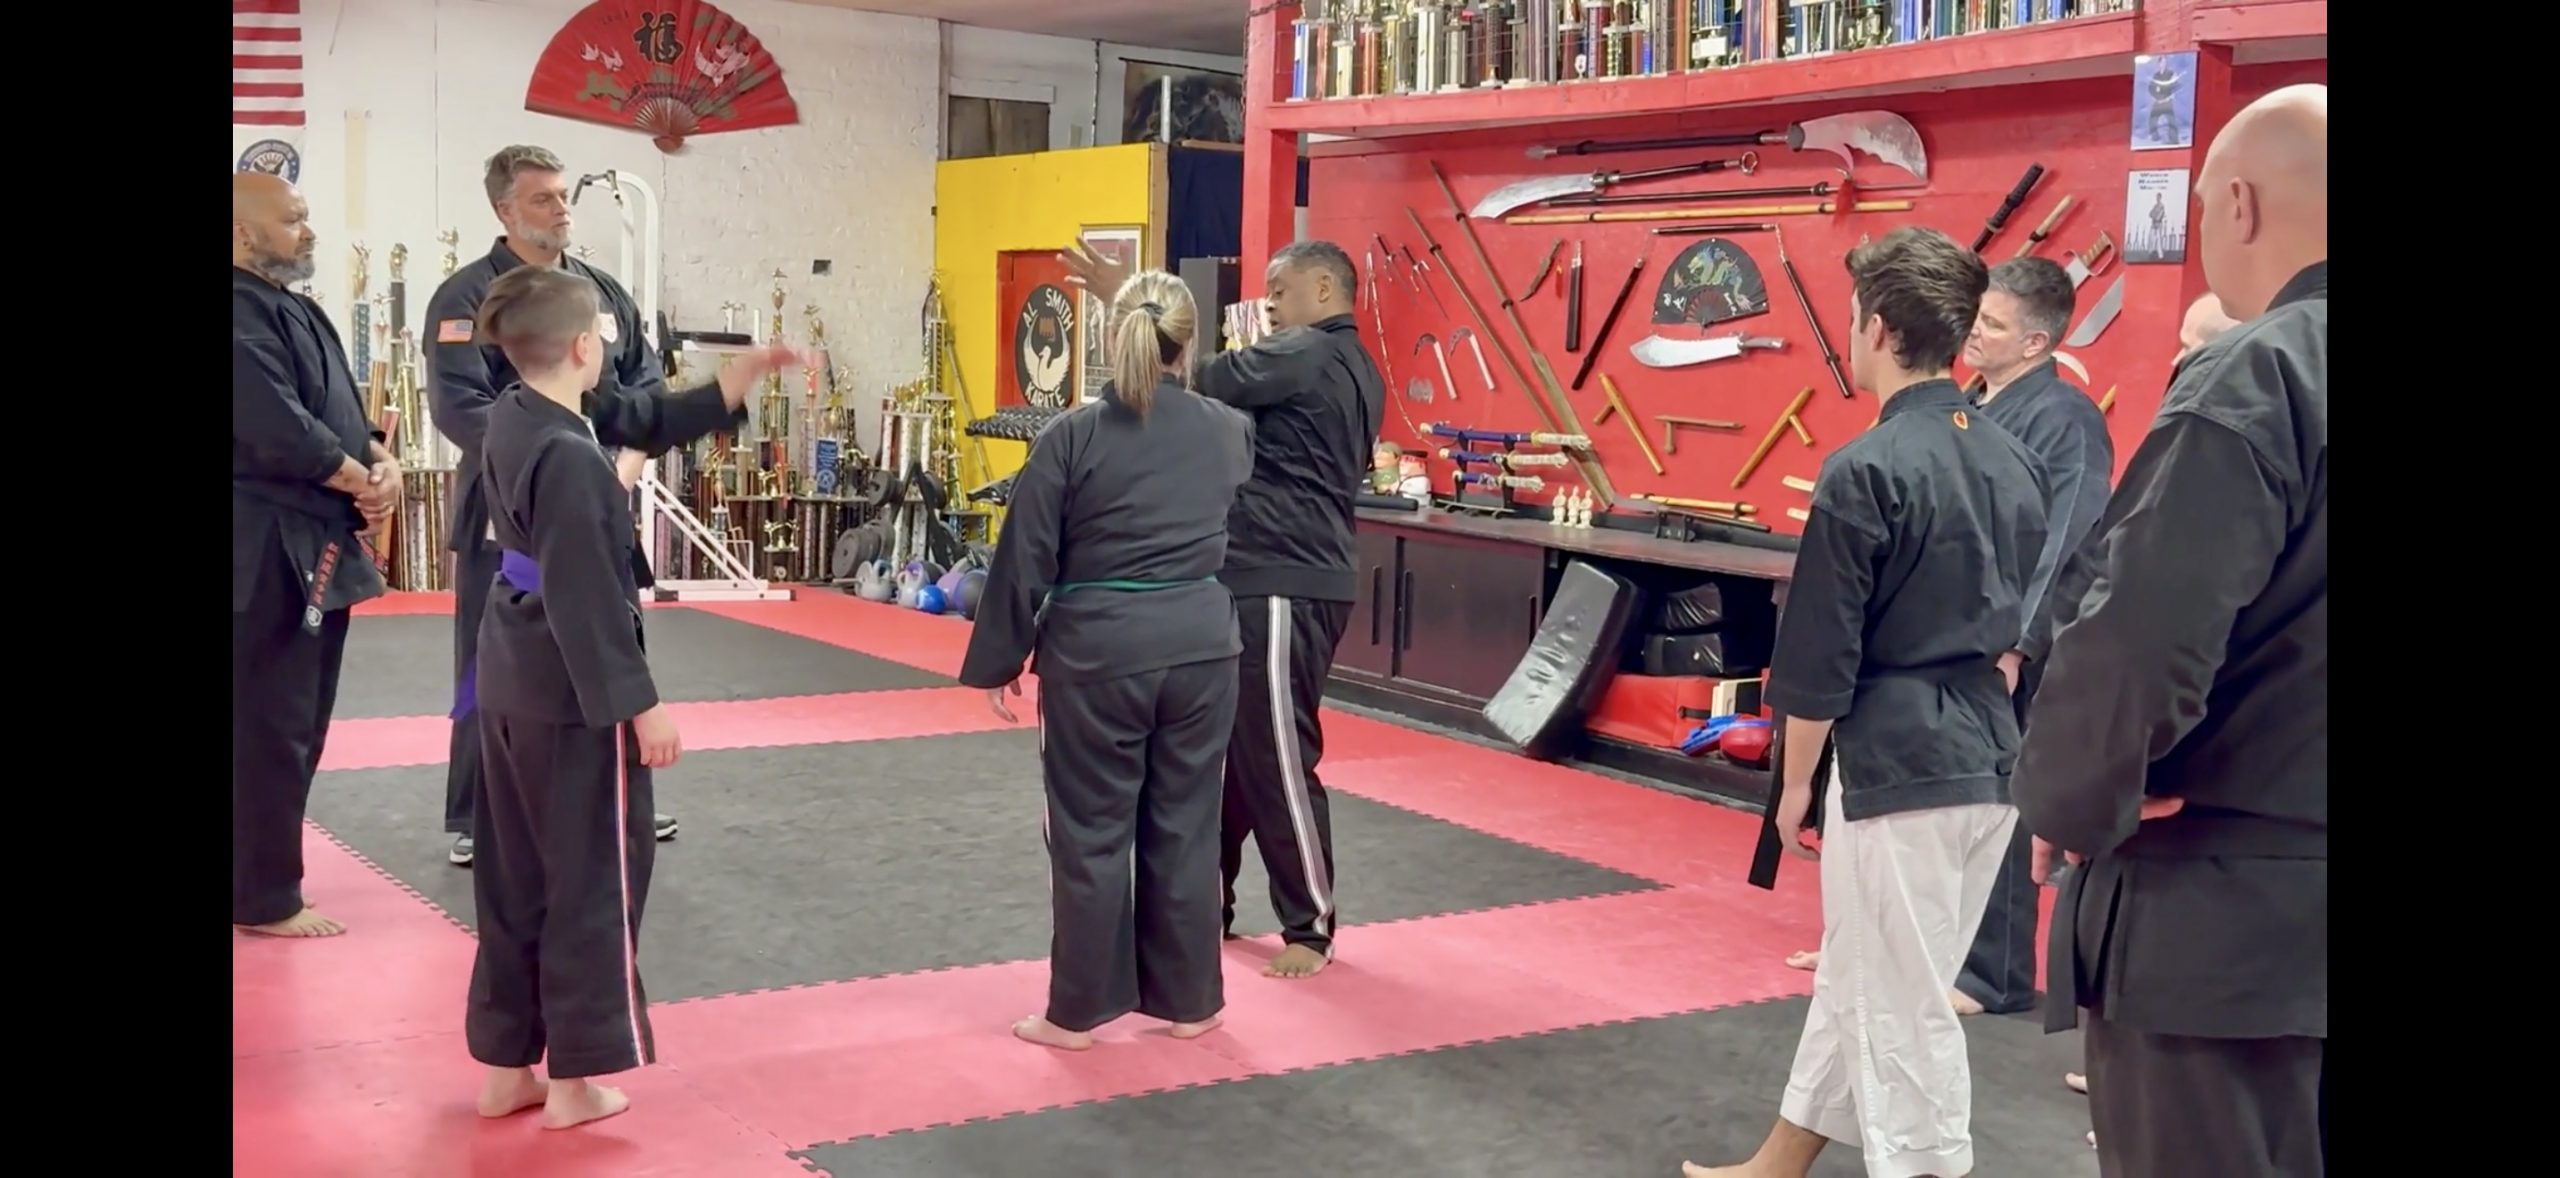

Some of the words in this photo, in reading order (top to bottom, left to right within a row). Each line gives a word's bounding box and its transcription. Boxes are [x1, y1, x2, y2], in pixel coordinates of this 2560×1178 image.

[1022, 301, 1038, 329] AL
[1045, 287, 1074, 332] SMITH
[1024, 381, 1065, 408] KARATE
